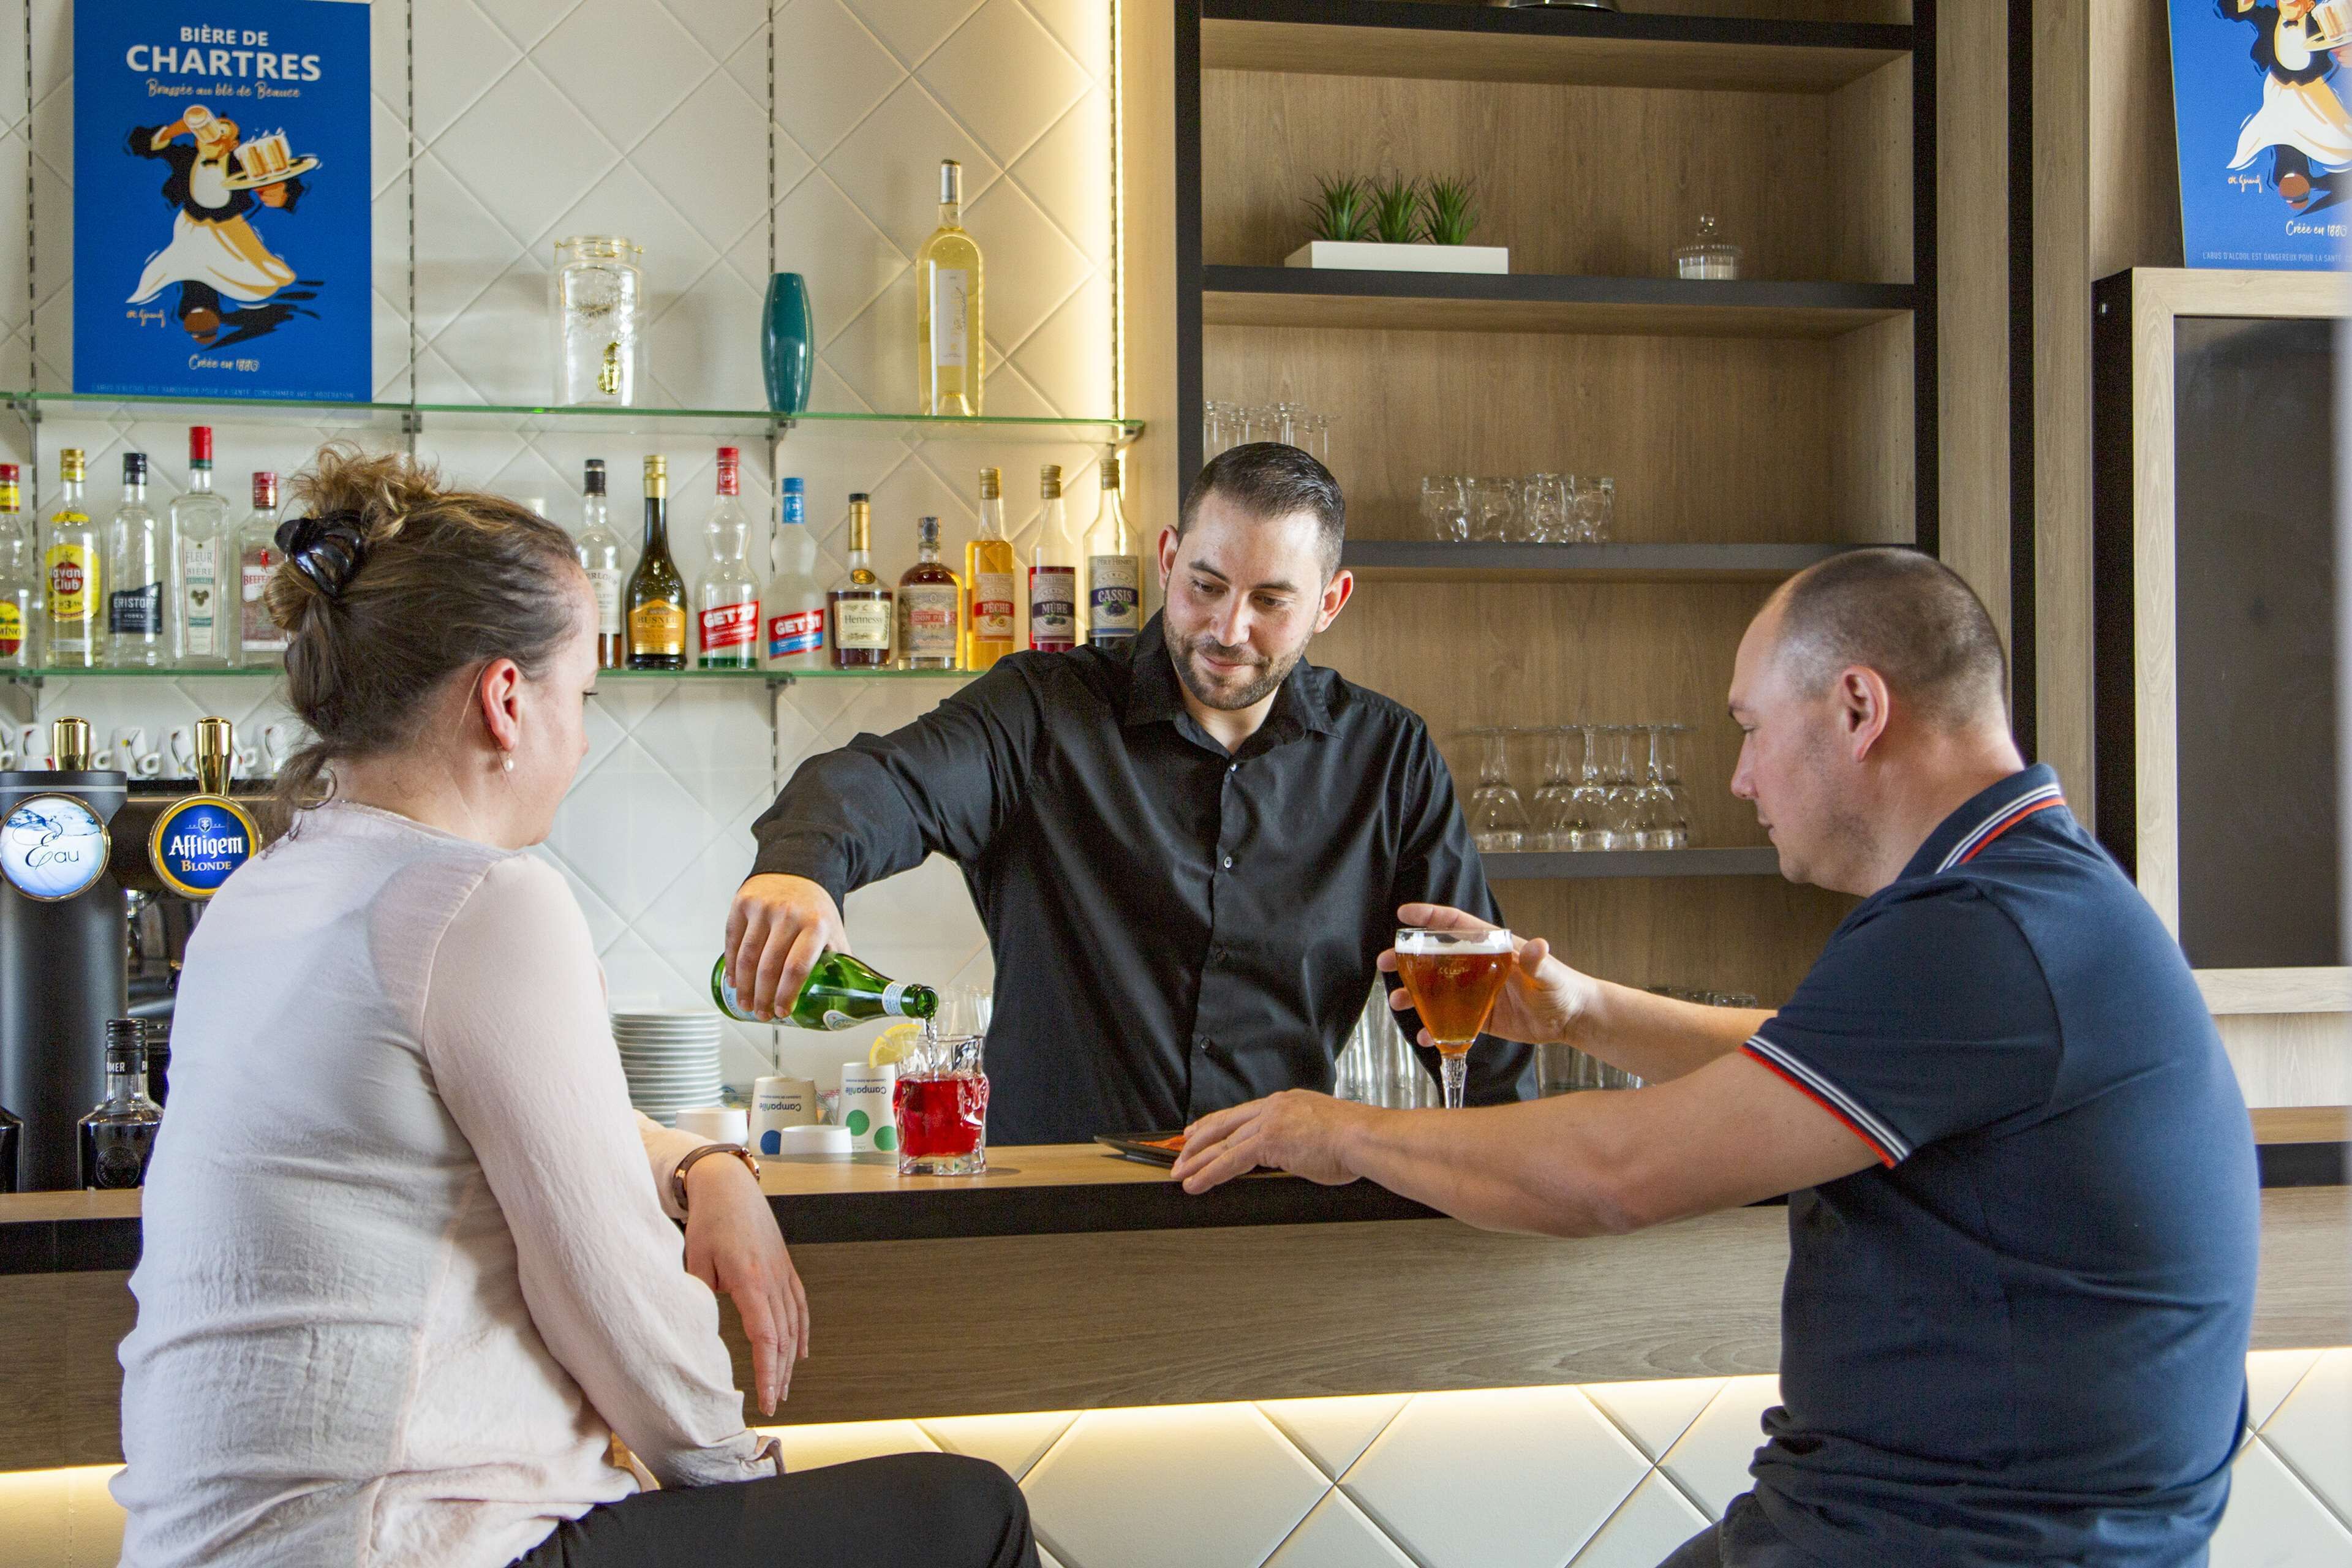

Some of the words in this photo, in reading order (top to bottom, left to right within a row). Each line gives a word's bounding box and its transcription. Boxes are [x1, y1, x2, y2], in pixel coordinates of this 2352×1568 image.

[181, 23, 236, 45] BIÈRE
[243, 30, 269, 47] DE
[126, 44, 322, 81] CHARTRES
[195, 87, 213, 96] au
[236, 85, 252, 97] de
[255, 80, 300, 99] Beauce
[2285, 220, 2312, 236] Créée
[2313, 225, 2325, 236] en
[2203, 251, 2222, 260] L'ABUS
[2223, 252, 2250, 260] D'ALCOOL
[2252, 252, 2261, 261] EST
[2263, 252, 2297, 262] DANGEREUX
[2298, 253, 2313, 262] POUR
[2315, 254, 2323, 262] LA
[186, 551, 213, 564] FLEUR
[53, 578, 79, 590] Club
[113, 597, 157, 608] ERISTOFF
[1097, 589, 1133, 603] CASSIS
[703, 609, 736, 628] GET
[737, 604, 756, 621] 27
[845, 614, 883, 624] Hennessy
[775, 617, 805, 636] GET
[12, 820, 80, 870] Eau
[168, 834, 243, 860] Affligem
[845, 1085, 887, 1095] Campanile
[759, 1101, 802, 1112] Campanile
